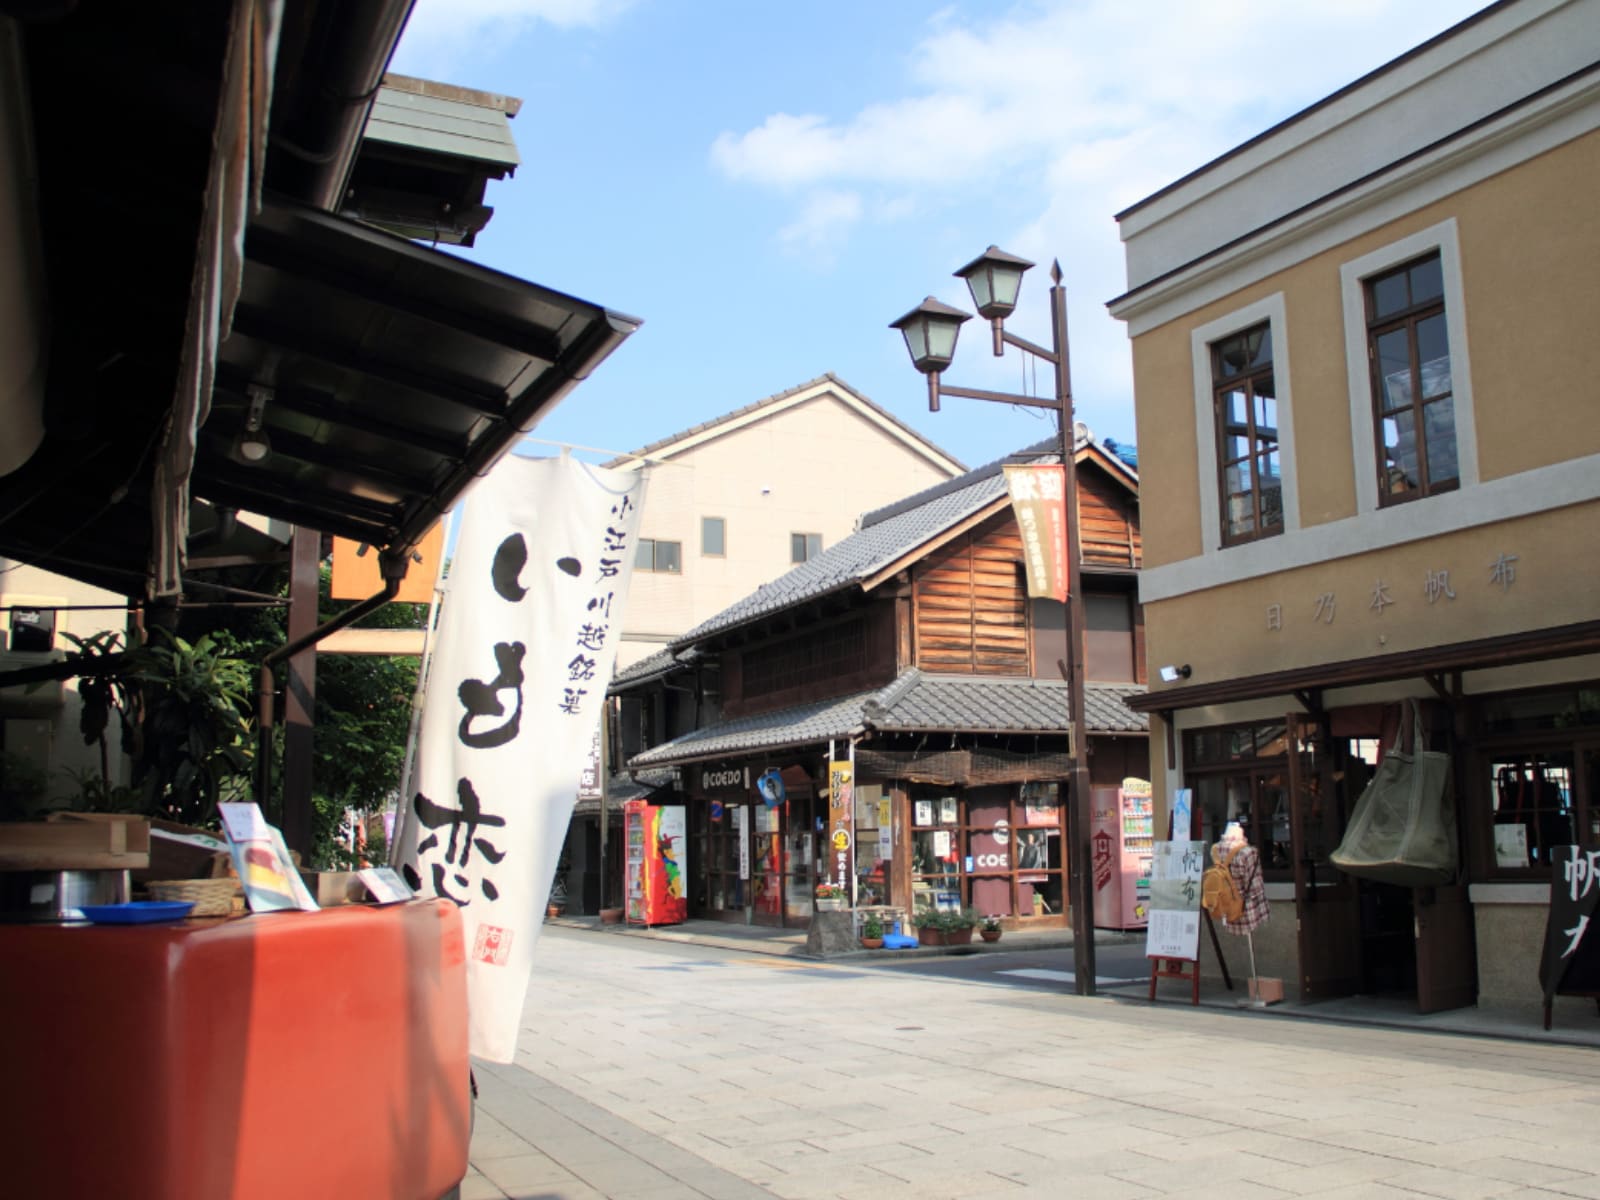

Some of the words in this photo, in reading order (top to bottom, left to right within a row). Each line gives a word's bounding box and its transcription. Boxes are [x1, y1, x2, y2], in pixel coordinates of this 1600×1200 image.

[557, 495, 634, 716] 小江戸川越銘菓
[1266, 552, 1520, 632] 日乃本帆布
[403, 532, 581, 906] いも恋
[710, 769, 741, 787] COEDO
